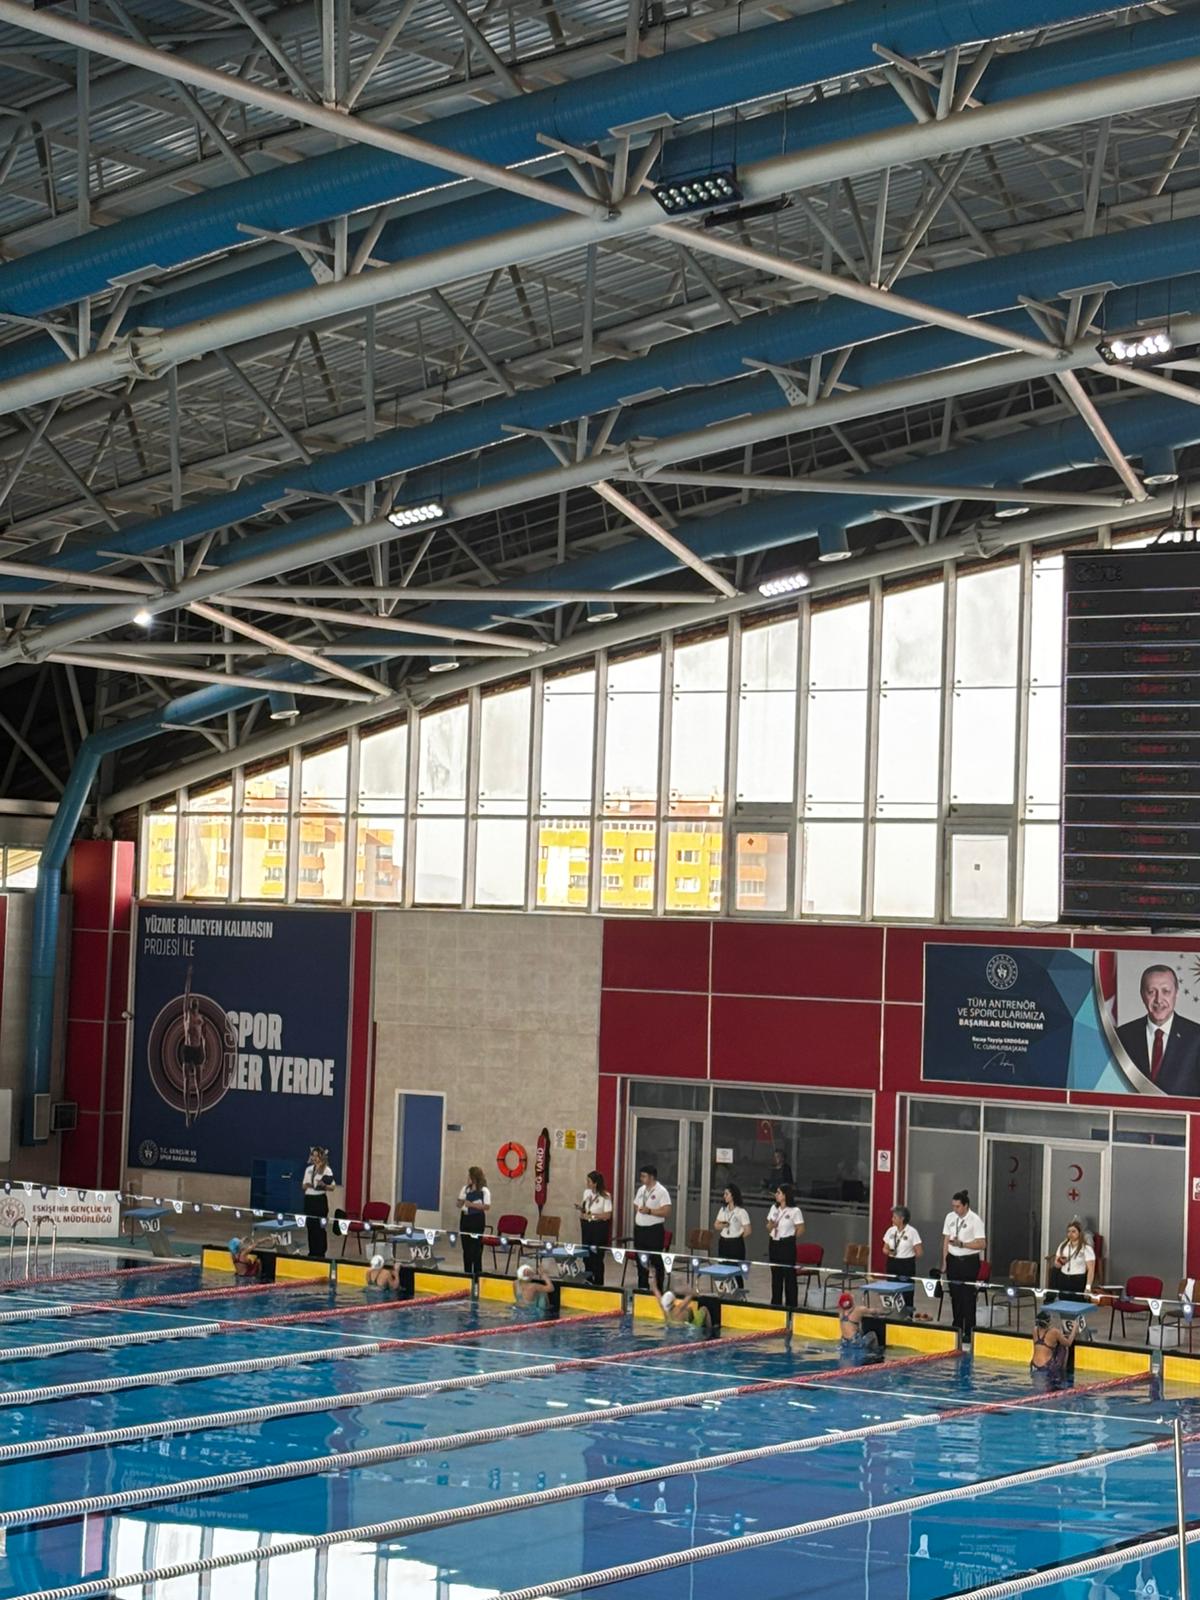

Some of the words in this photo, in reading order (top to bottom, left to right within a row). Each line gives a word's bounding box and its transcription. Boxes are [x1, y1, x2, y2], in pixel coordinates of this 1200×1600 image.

[145, 915, 176, 935] YÜZME
[177, 915, 222, 937] BİLMEYEN
[224, 920, 273, 939] KALMASIN
[144, 938, 180, 956] PROJESİ
[182, 937, 195, 957] İLE
[967, 997, 987, 1009] TÜM
[988, 999, 1036, 1011] ANTRENÖR
[957, 1007, 968, 1017] VE
[970, 1008, 1046, 1021] SPORCULARIMIZA
[223, 1010, 283, 1051] SPOR
[958, 1018, 1000, 1028] BAŞARILAR
[1001, 1019, 1044, 1030] DİLİYORUM
[223, 1052, 263, 1092] HER
[268, 1055, 335, 1097] YERDE
[32, 1204, 69, 1214] ESKİŞEHİR
[71, 1205, 101, 1215] GENÇLİK
[63, 1214, 112, 1224] MÜDÜRLÜĞÜ
